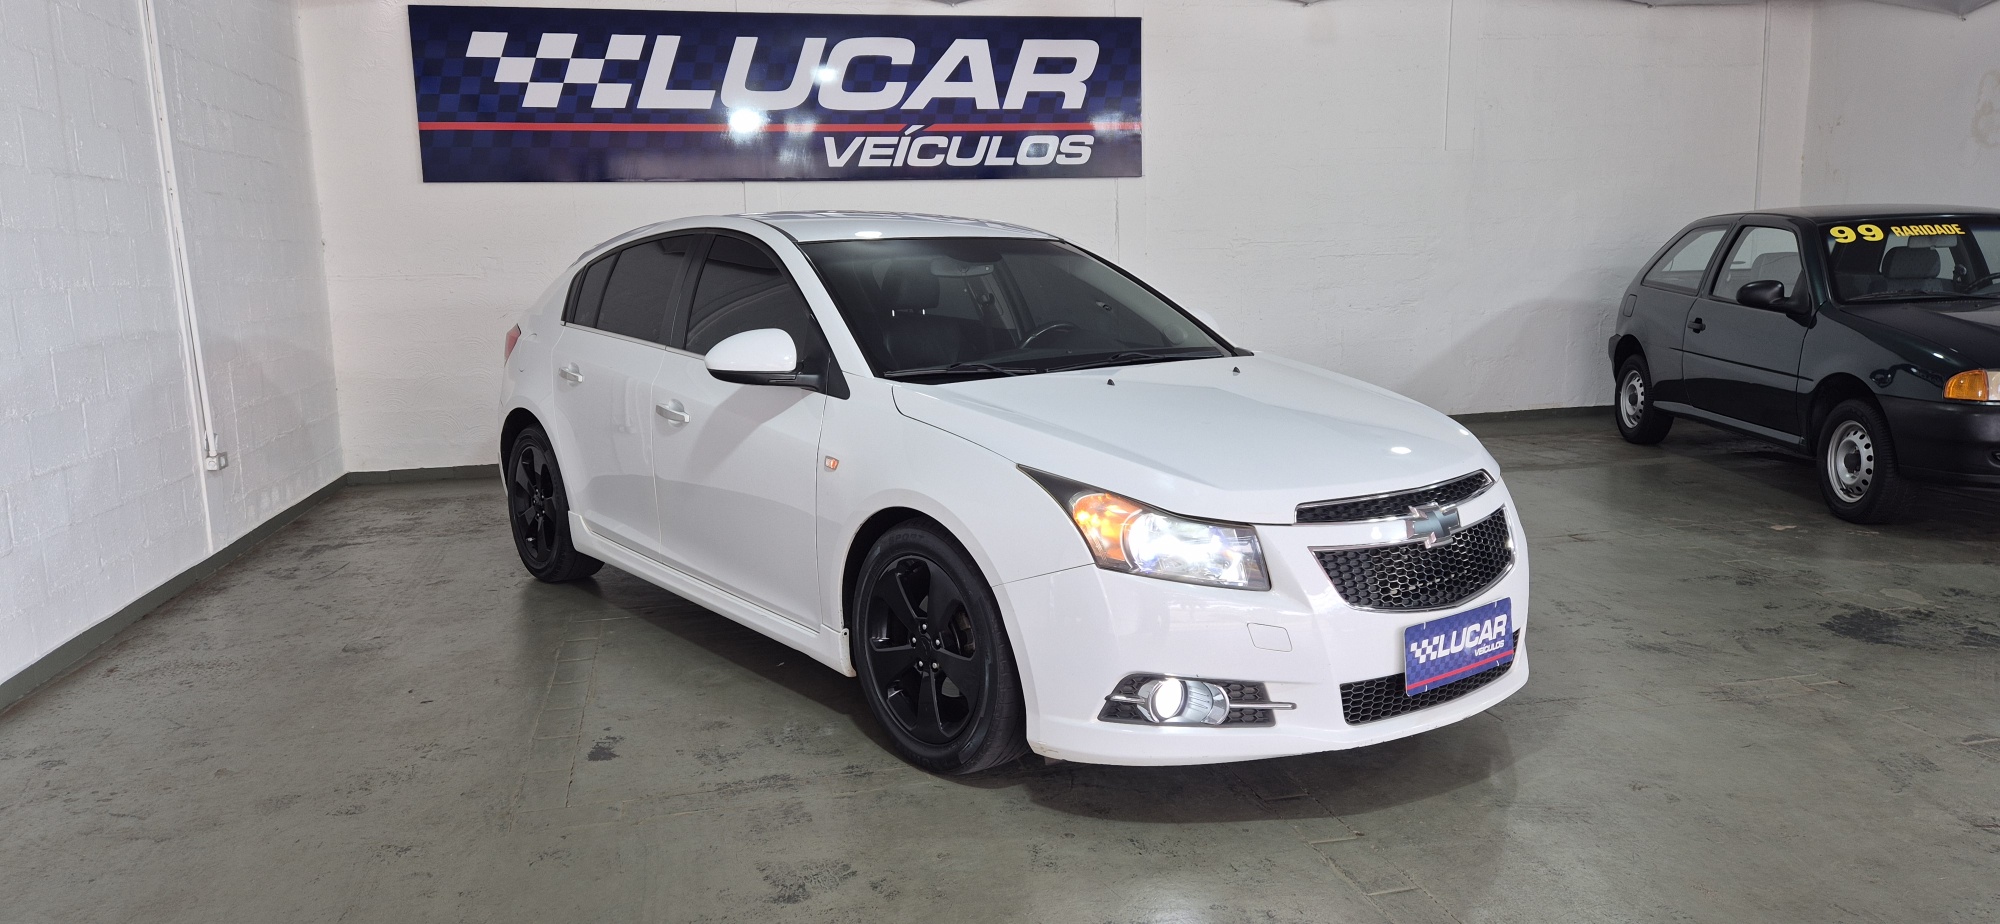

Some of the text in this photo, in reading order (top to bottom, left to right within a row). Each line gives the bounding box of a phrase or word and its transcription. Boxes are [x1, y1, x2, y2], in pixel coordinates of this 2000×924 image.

[637, 34, 1100, 111] LUCAR
[824, 124, 1094, 168] VEÍCULOS
[1829, 223, 1966, 243] 99 RARIDADE
[1437, 613, 1507, 658] LUCAR
